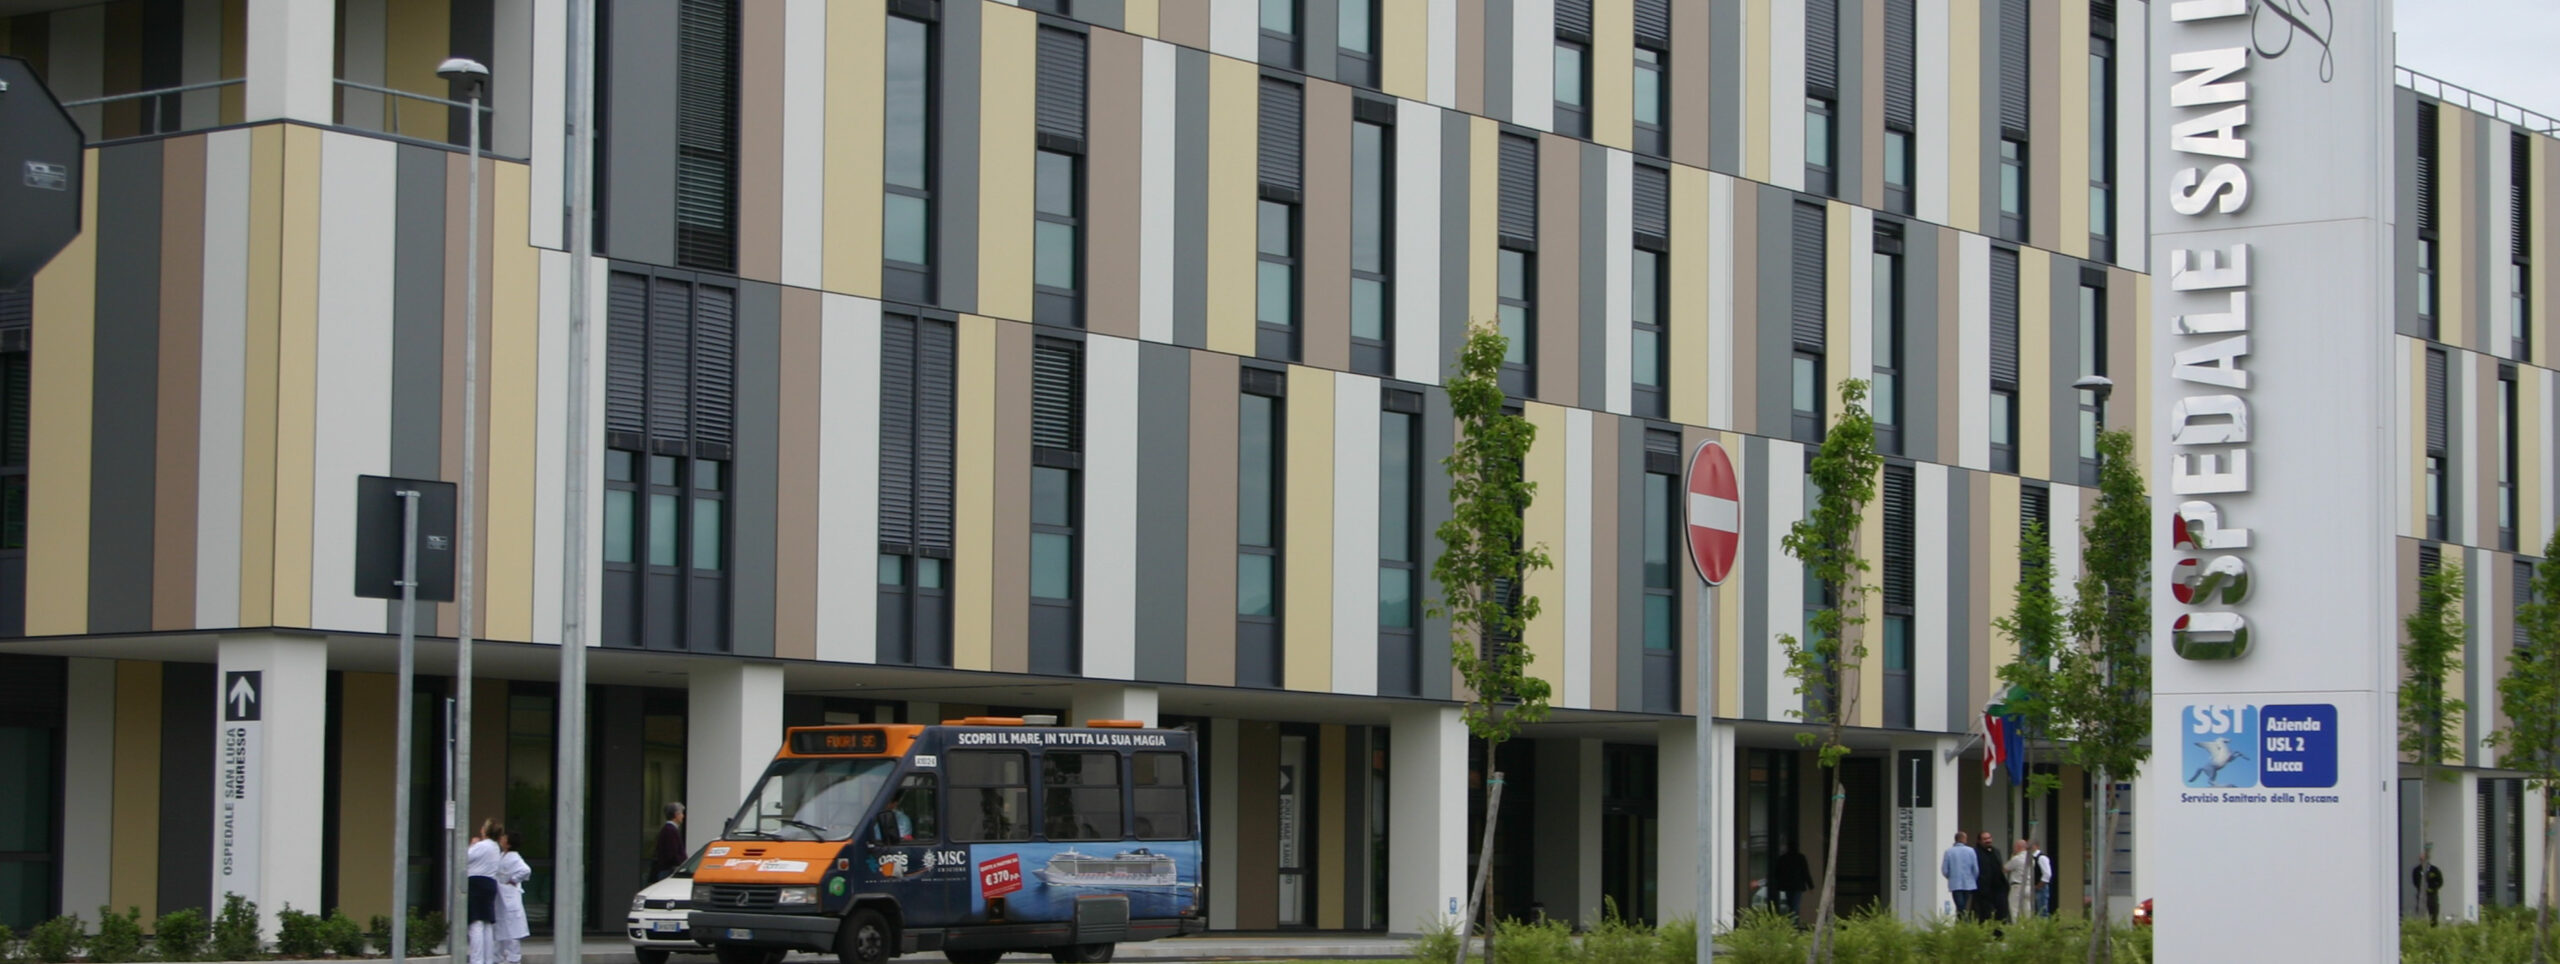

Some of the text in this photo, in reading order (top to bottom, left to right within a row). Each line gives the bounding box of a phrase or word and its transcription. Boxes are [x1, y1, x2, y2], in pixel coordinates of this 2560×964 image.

[2170, 46, 2251, 216] SAN
[2171, 243, 2253, 661] OSPEDALE
[2192, 704, 2248, 734] SST
[2266, 717, 2321, 731] Azienda
[958, 733, 1166, 747] SCOPRI IL MARE, IN TUTTA LA SUA MAGIA
[2266, 737, 2305, 752] USL 2
[235, 727, 247, 800] INGRESSO
[2266, 757, 2303, 772] Lucca
[222, 727, 236, 876] OSPEDALE SAN LUCA
[2181, 793, 2339, 803] Servizio Sanitario della Toscana
[937, 850, 966, 865] MSC
